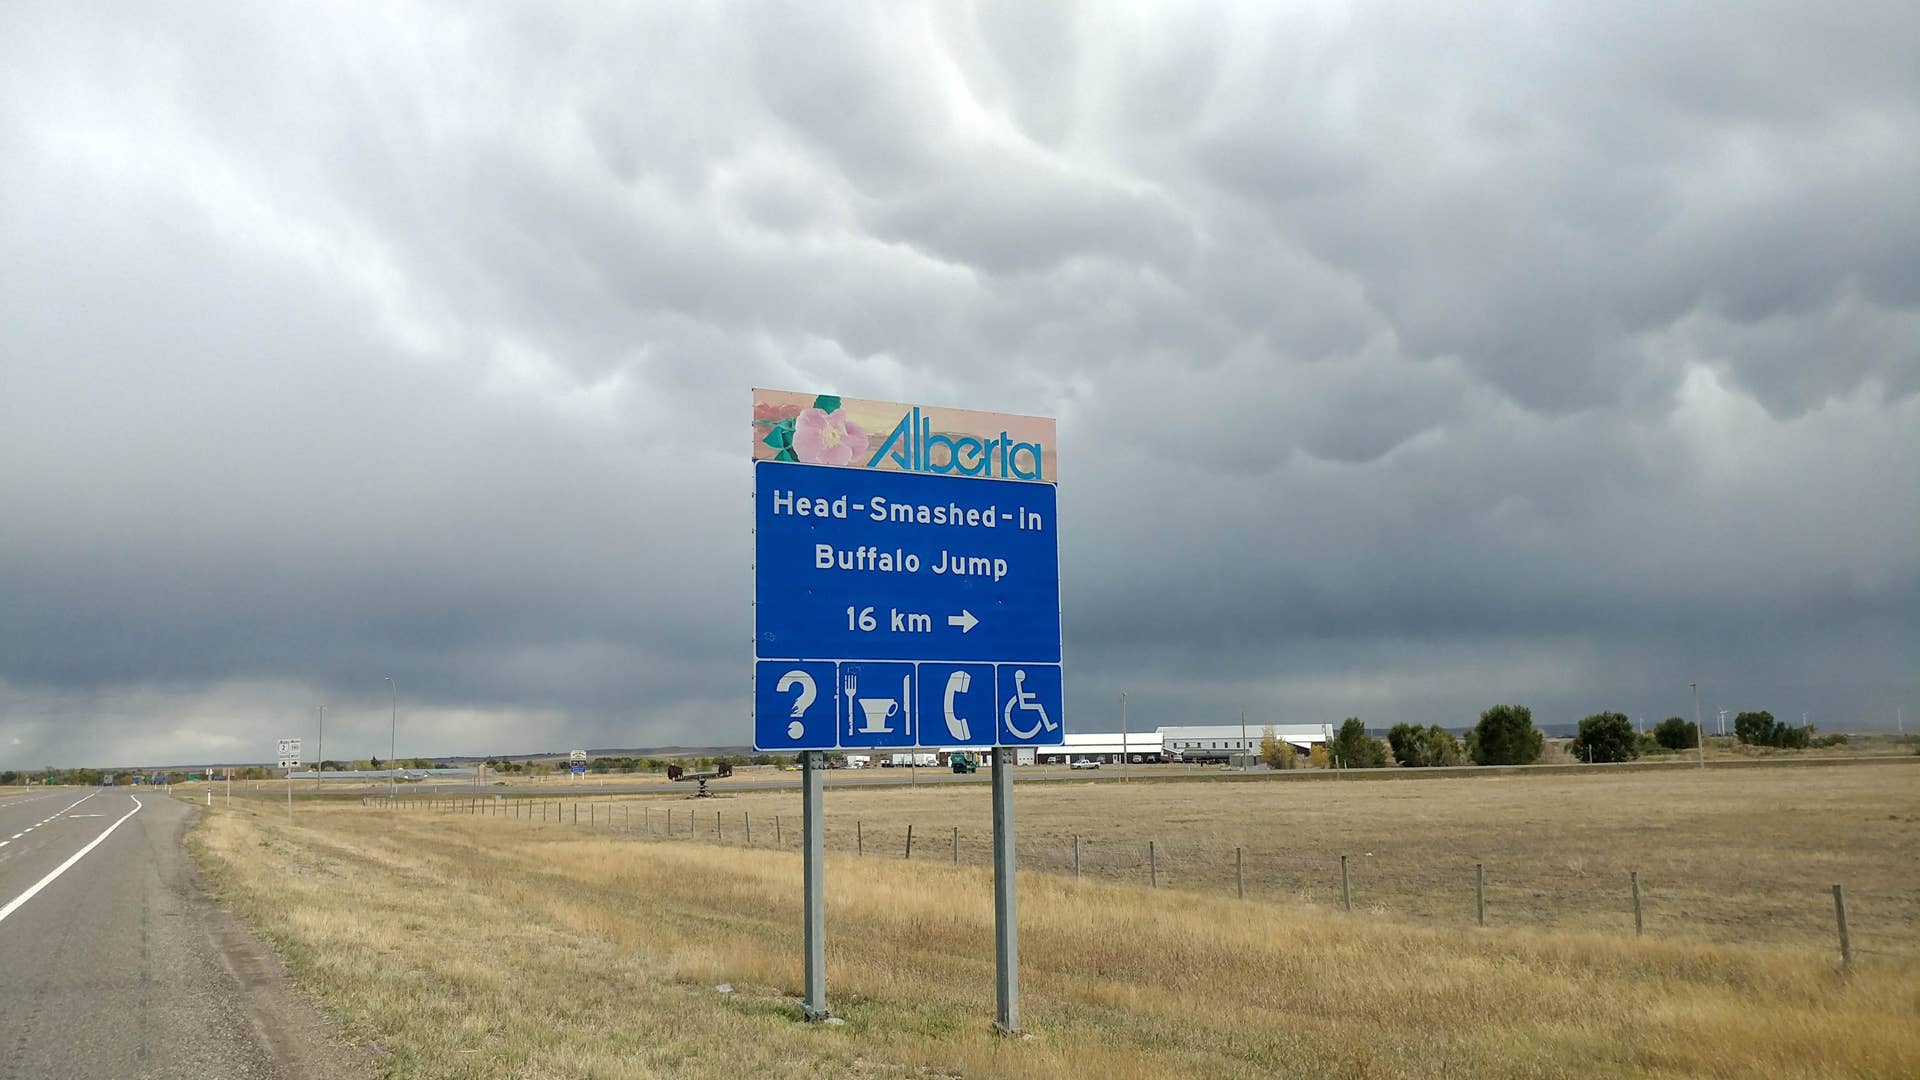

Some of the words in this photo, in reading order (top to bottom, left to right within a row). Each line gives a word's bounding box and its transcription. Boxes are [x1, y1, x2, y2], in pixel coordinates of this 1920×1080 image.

[868, 407, 1042, 480] Alberta
[774, 490, 1042, 531] Head-Smashed-In
[815, 543, 921, 573] Buffalo
[931, 550, 1008, 582] Jump
[847, 606, 877, 632] 16
[891, 608, 931, 633] km
